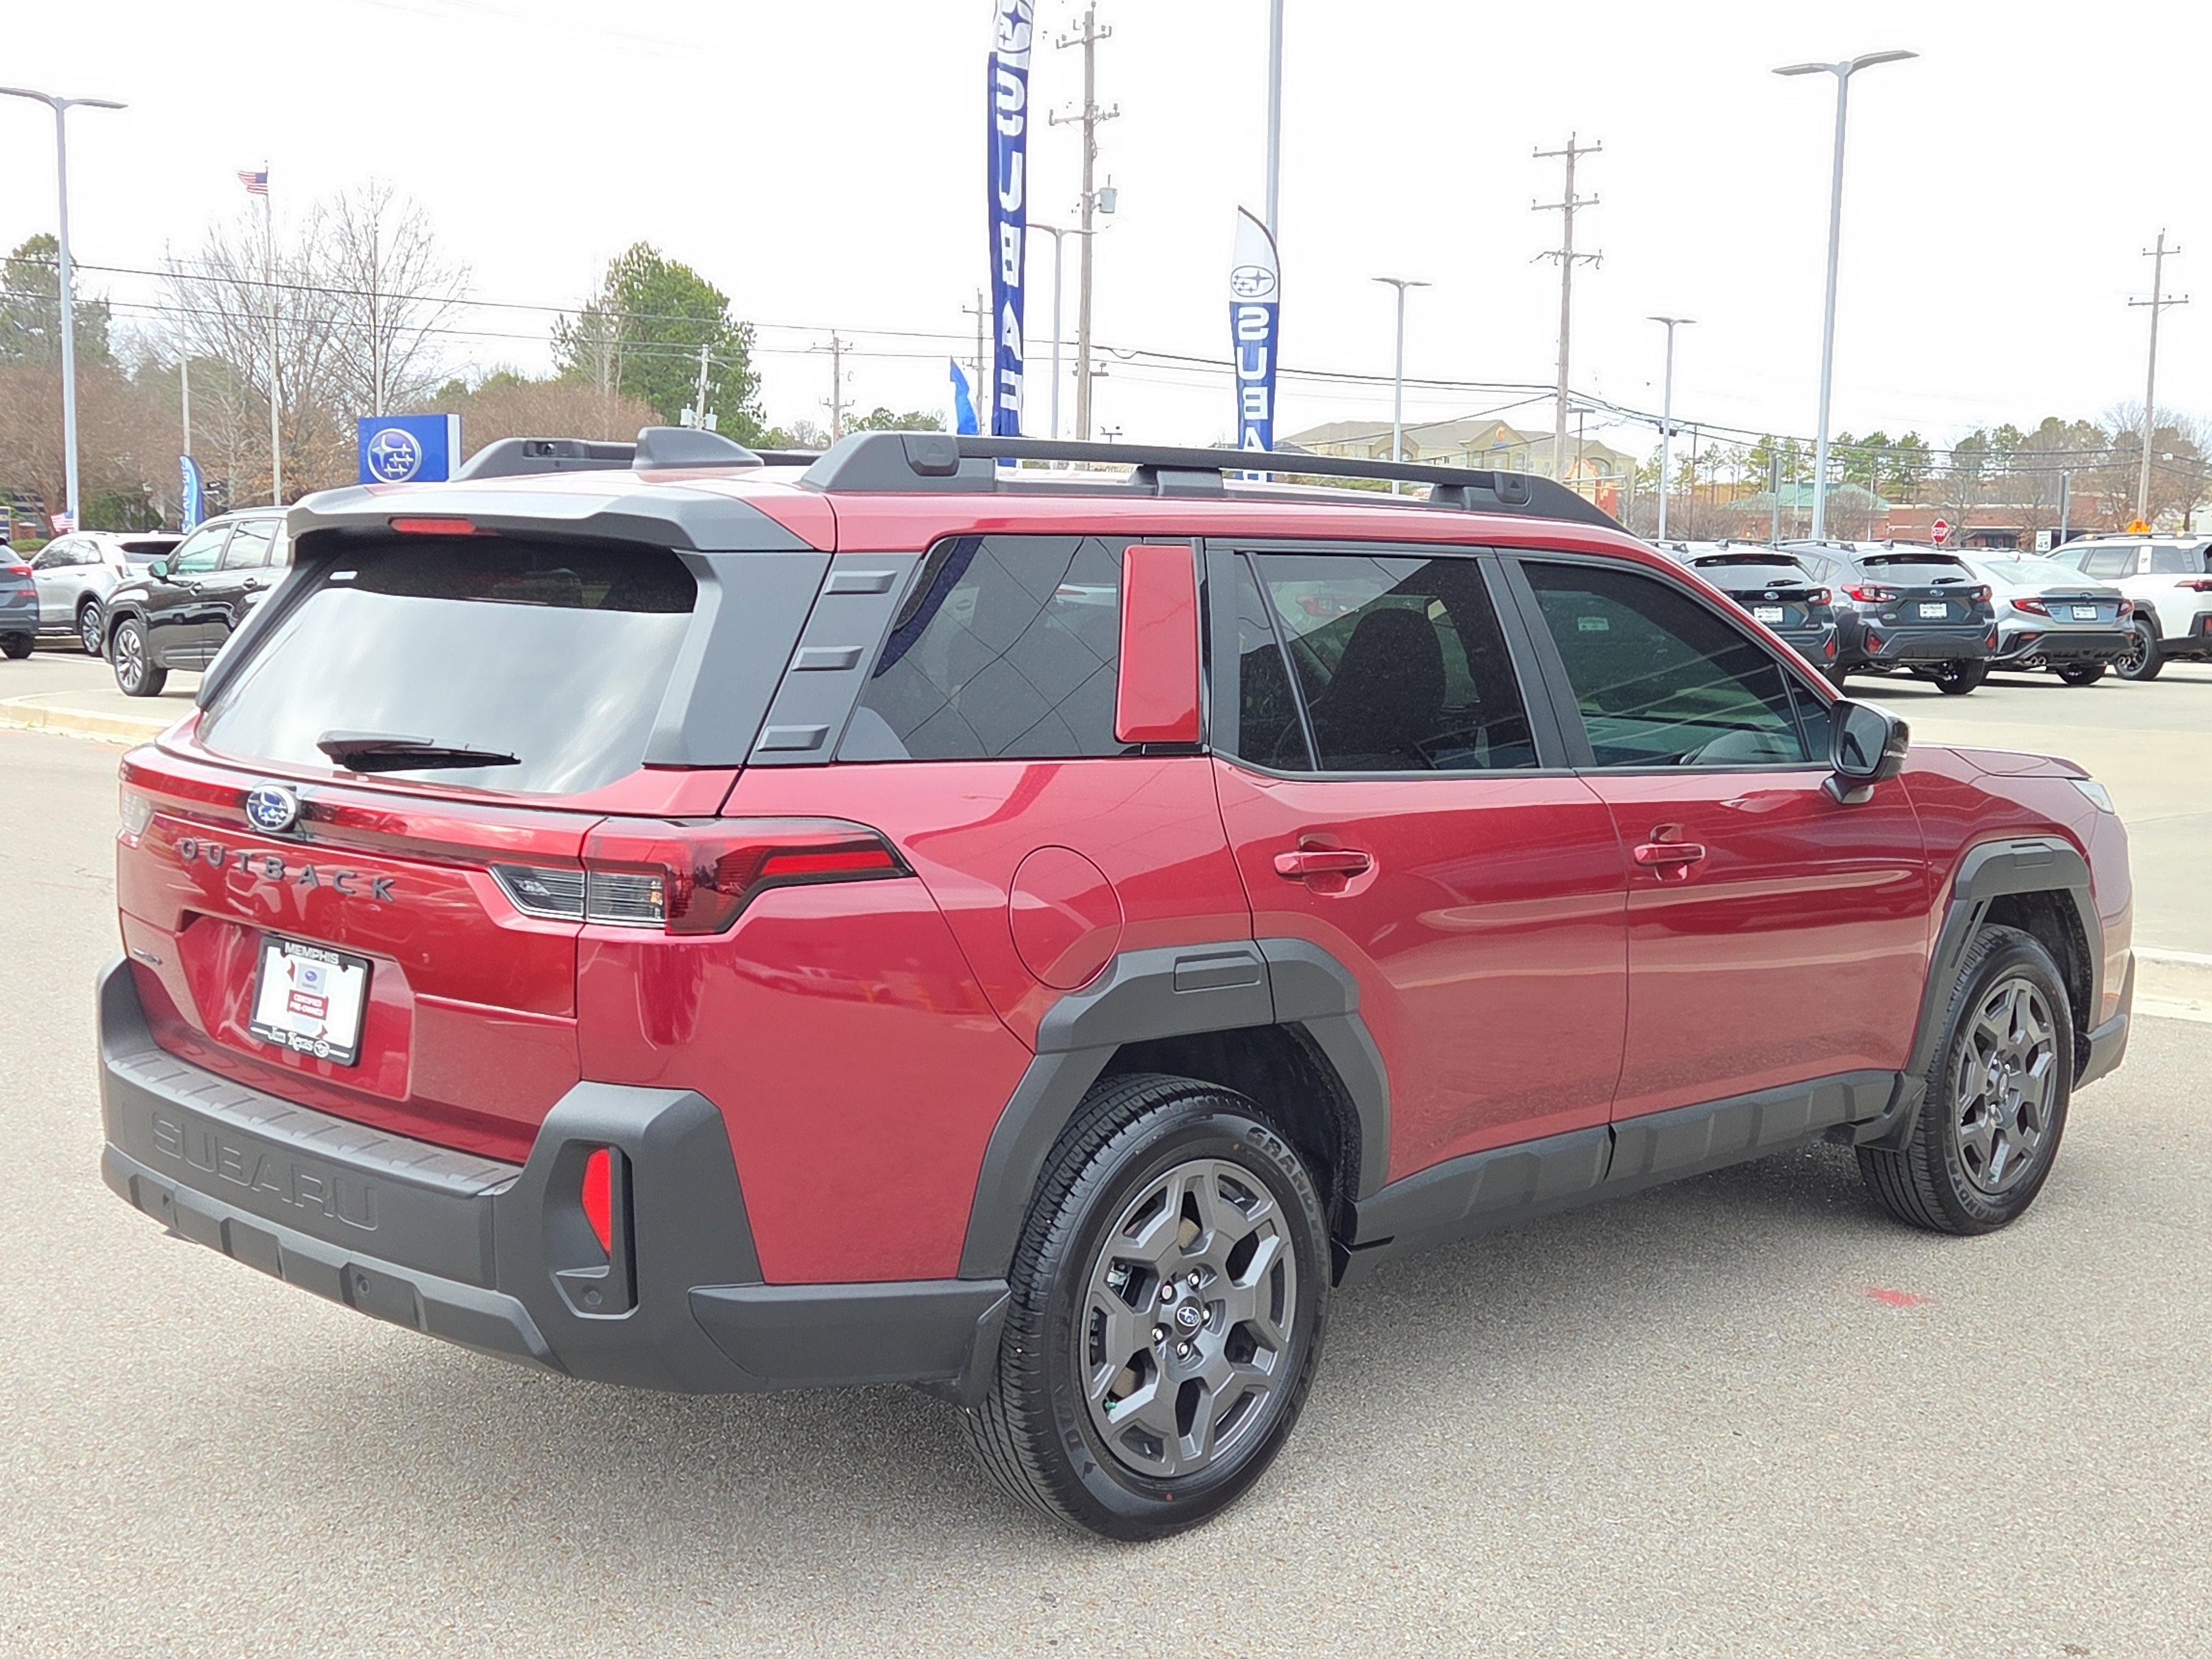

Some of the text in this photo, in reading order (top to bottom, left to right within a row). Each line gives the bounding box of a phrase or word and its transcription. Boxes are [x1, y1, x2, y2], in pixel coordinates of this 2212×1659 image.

[180, 837, 396, 903] OUTBACK
[285, 942, 340, 964] MEMPHIS
[151, 1111, 379, 1232] SUBARU
